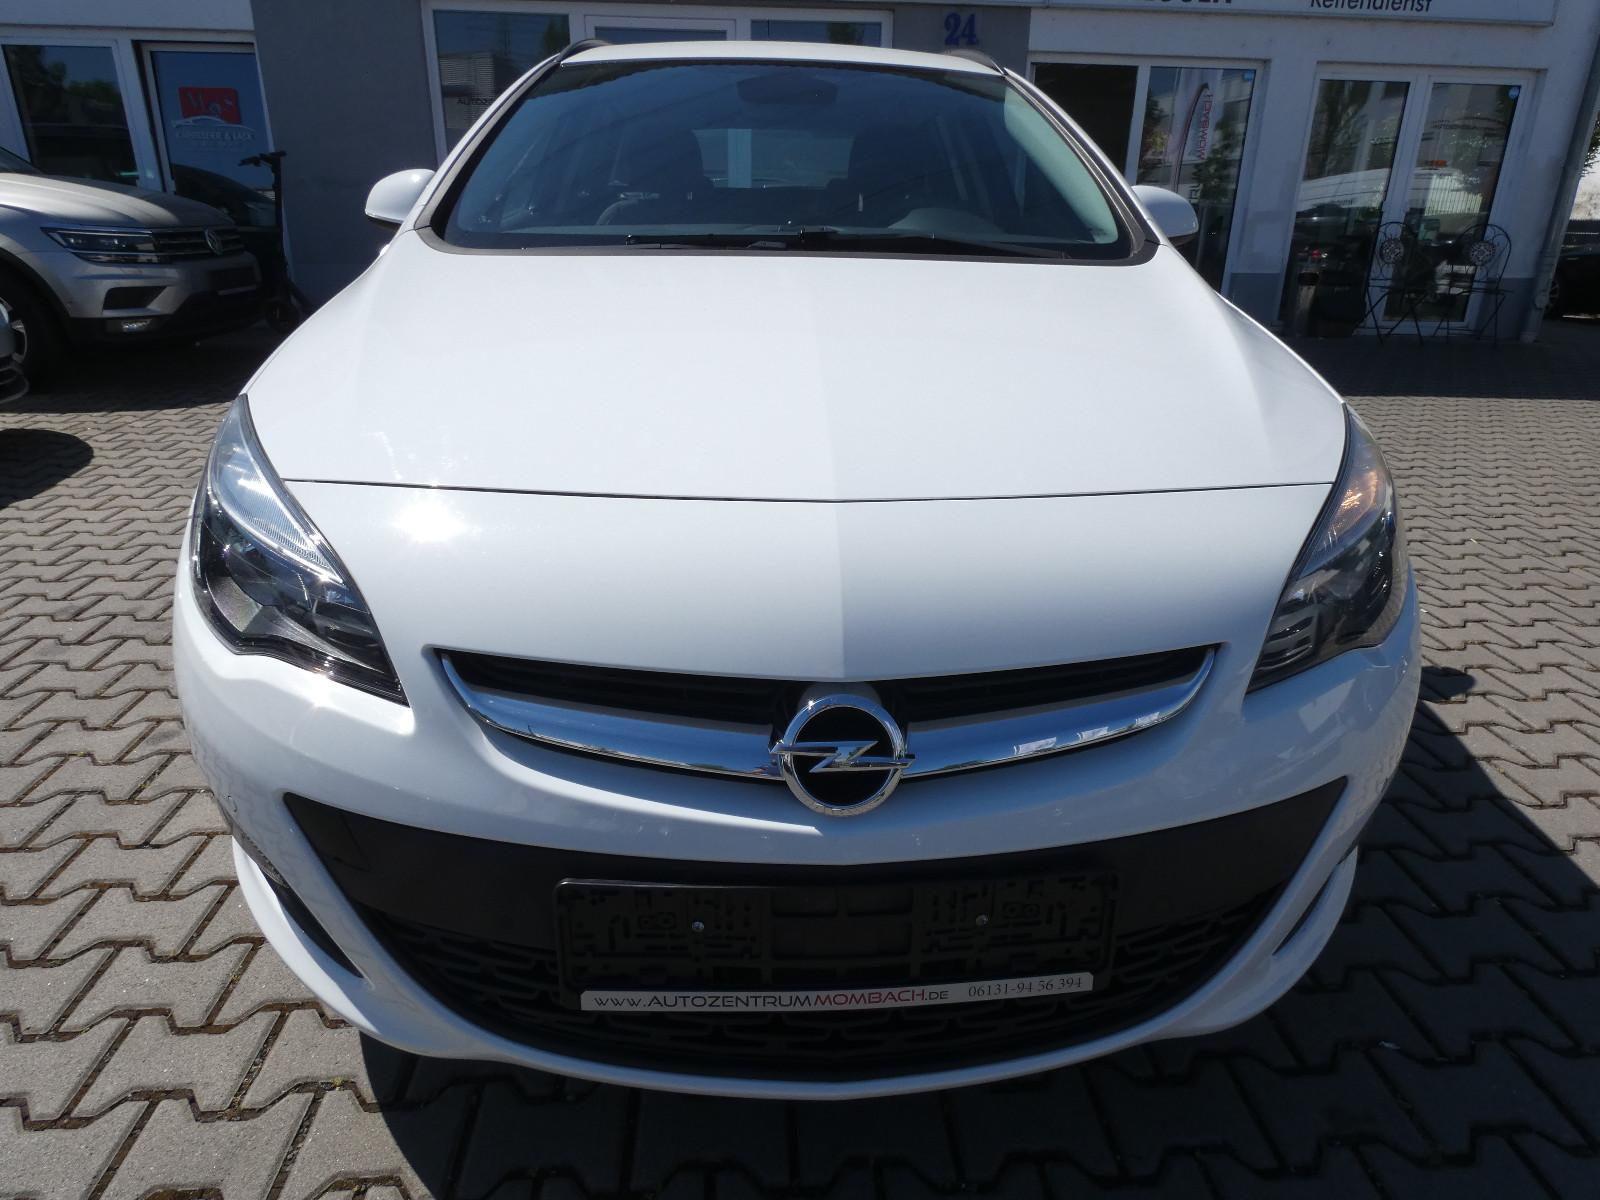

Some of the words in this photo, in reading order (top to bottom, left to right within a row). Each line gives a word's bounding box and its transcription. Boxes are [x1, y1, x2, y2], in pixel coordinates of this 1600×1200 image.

[944, 12, 978, 46] 24
[968, 982, 1033, 998] 06131-94
[1037, 978, 1054, 993] 56
[1058, 976, 1083, 990] 394
